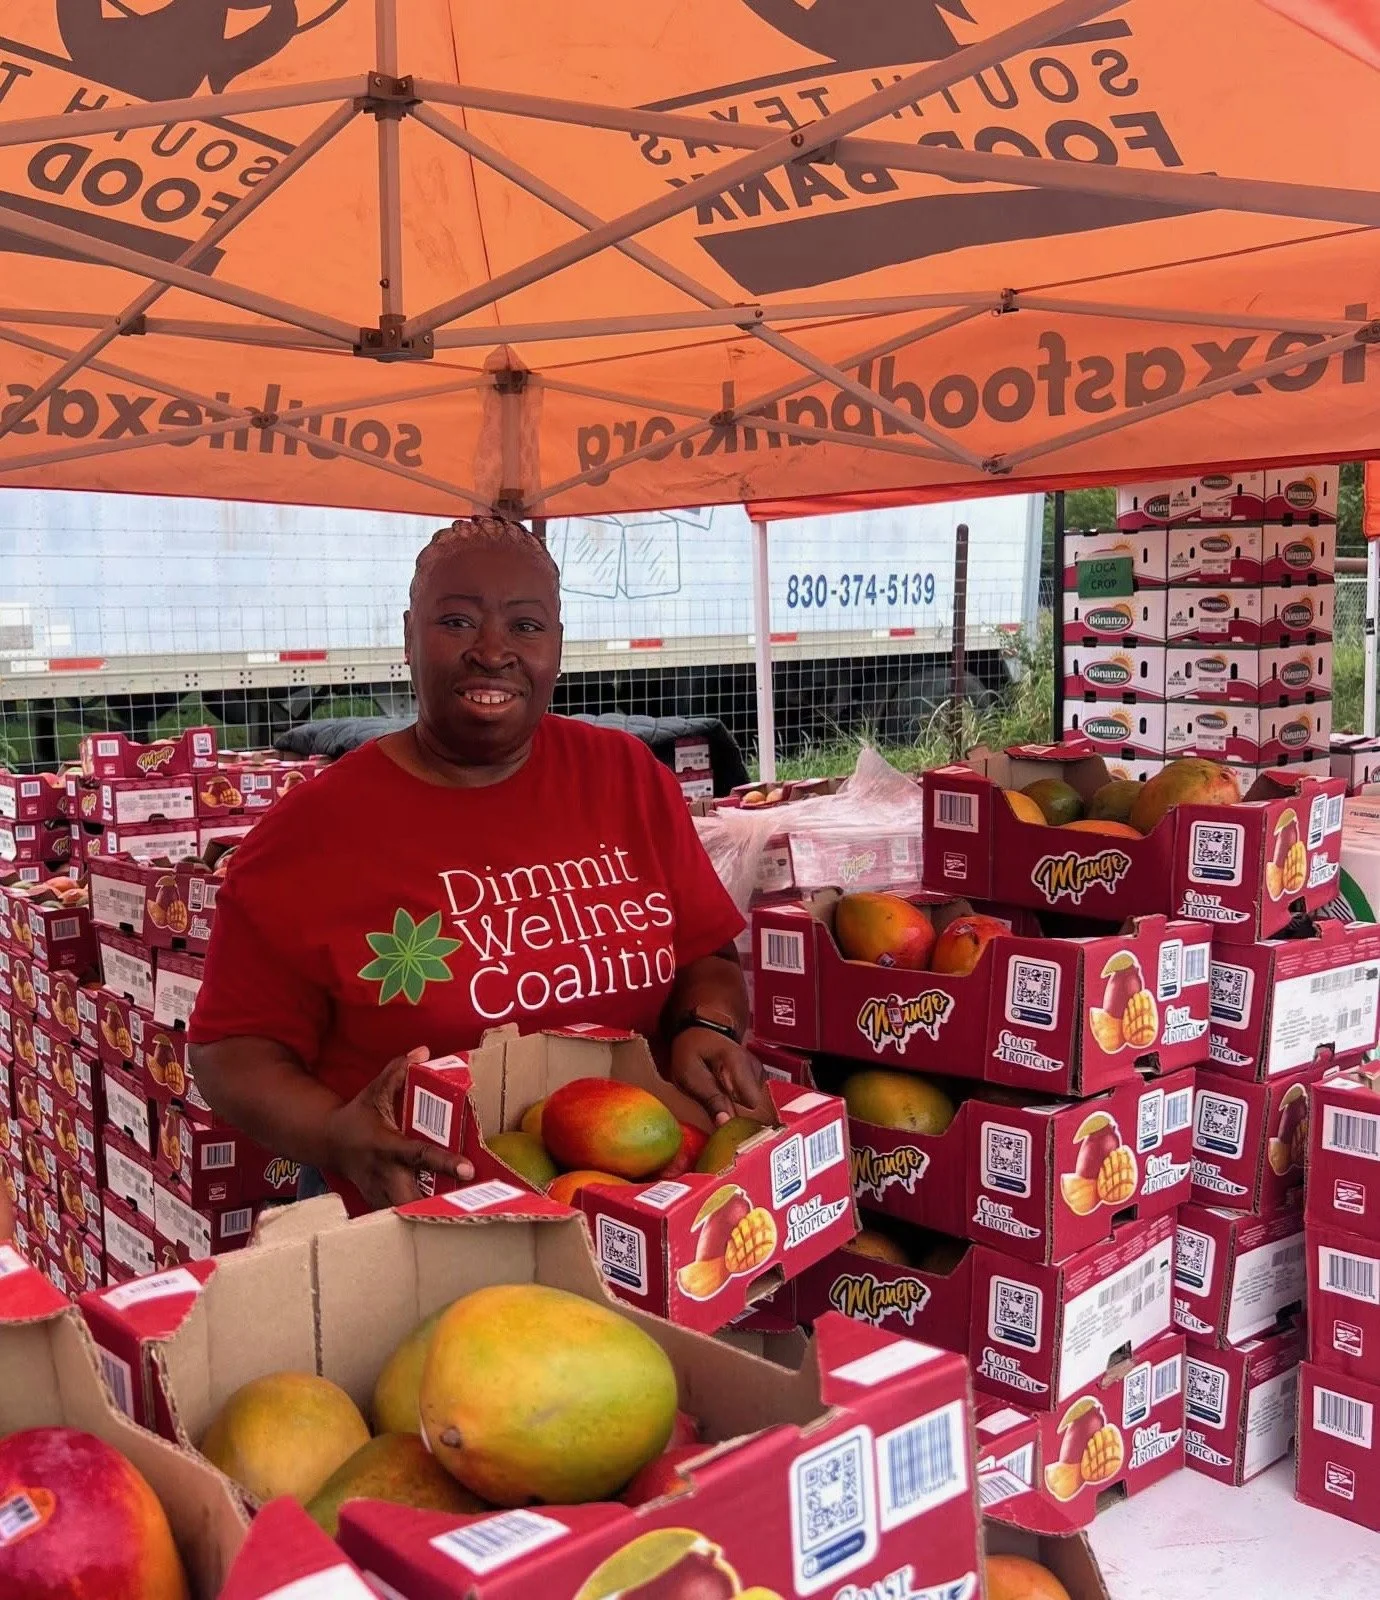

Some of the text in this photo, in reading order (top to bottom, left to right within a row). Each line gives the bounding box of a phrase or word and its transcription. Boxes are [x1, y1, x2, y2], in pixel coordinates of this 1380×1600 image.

[787, 573, 935, 609] 830-374-5139
[1091, 578, 1117, 591] CROP
[438, 843, 639, 916] Dimmit
[1034, 851, 1131, 900] Mango
[1184, 890, 1219, 906] COAST
[1183, 904, 1236, 921] TROPICAL
[469, 940, 675, 1019] Coalitio
[1166, 1008, 1188, 1026] COAST
[1001, 1031, 1036, 1053] COAST
[999, 1045, 1052, 1071] TROPICAL
[1146, 1156, 1170, 1176] COAST
[1144, 1168, 1181, 1194] TROPICAL
[788, 1195, 821, 1226] COAST
[979, 1197, 1013, 1219] COAST
[788, 1204, 839, 1243] TROPICAL
[978, 1211, 1029, 1238] TROPICAL
[831, 1275, 927, 1322] Mango
[984, 1348, 1020, 1372] COAST
[983, 1362, 1036, 1392] TROPICAL
[1133, 1424, 1159, 1449] COAST
[1131, 1436, 1173, 1466] TROPICAL
